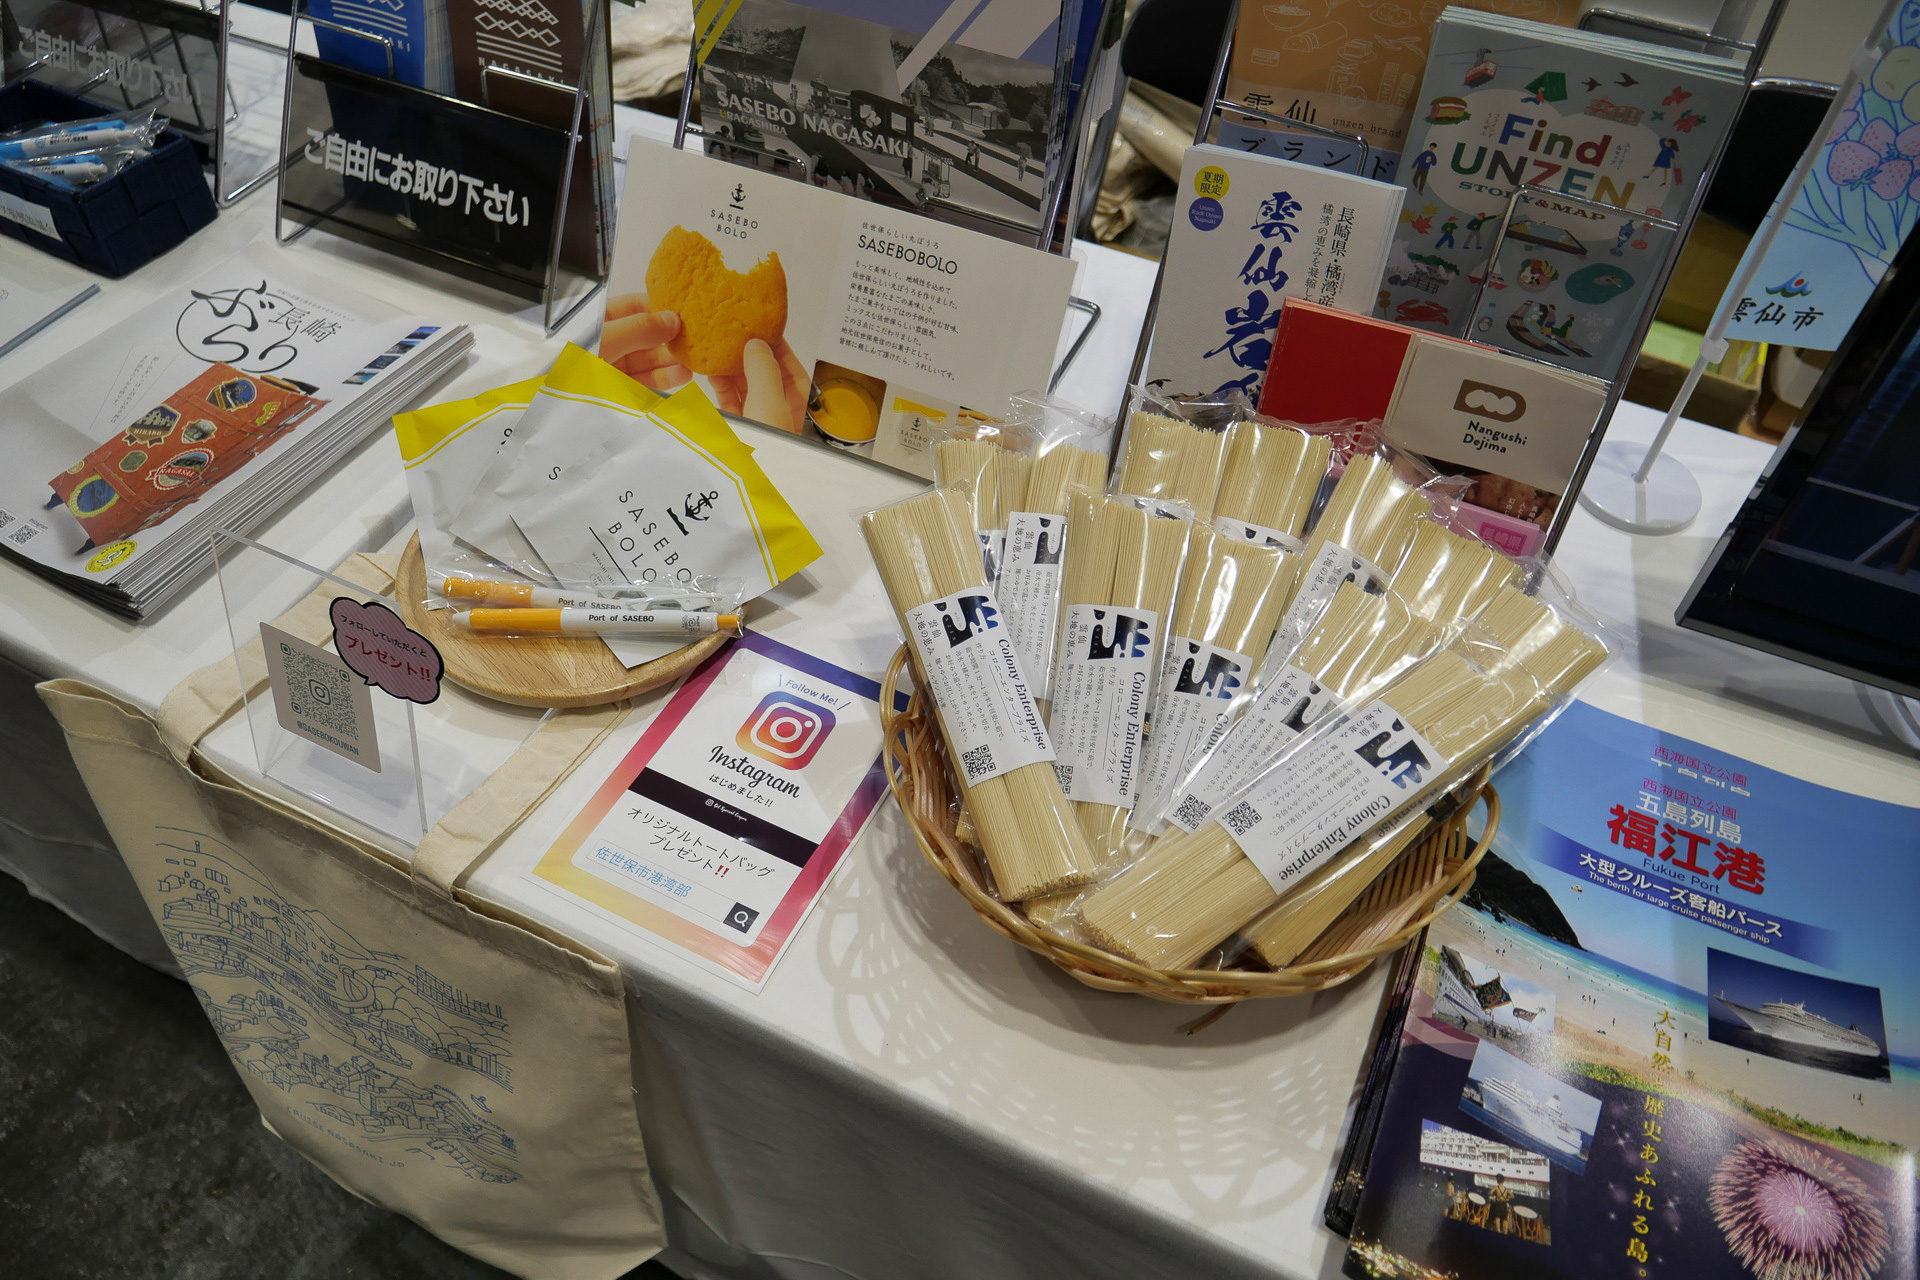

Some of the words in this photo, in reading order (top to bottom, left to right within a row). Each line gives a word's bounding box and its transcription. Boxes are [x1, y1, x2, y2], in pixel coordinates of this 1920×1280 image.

[716, 90, 797, 126] SASEBO
[802, 113, 909, 160] NAGASAKI
[719, 109, 788, 136] URAGASHIRA
[1332, 116, 1365, 131] unzen
[1370, 122, 1402, 138] brand
[1497, 109, 1612, 169] Find
[304, 127, 530, 227] ご自由にお取り下さい
[1203, 171, 1224, 186] 夏期
[1240, 137, 1394, 179] ブランド
[1448, 138, 1636, 215] UNZEN
[1200, 183, 1222, 197] 限定
[710, 209, 759, 230] SASEBO
[716, 224, 748, 240] BOLO
[857, 234, 959, 275] SASEBOBOLO
[268, 306, 343, 344] 長崎
[1462, 433, 1507, 454] Dejima
[1468, 420, 1528, 446] Nangushi
[606, 520, 660, 585] BOLO
[616, 488, 695, 586] SASEBO
[1011, 517, 1025, 563] 大地の恵み
[1023, 530, 1034, 550] 雲仙
[557, 597, 574, 605] Port
[588, 614, 605, 622] Port
[622, 614, 654, 622] SASEBO
[340, 614, 428, 659] フォローしていただくと
[911, 610, 937, 656] 大地の恵み
[926, 618, 942, 639] 雲仙
[974, 641, 986, 660] 作り方
[1065, 609, 1079, 659] 大地の恵み
[1077, 623, 1088, 644] 雲仙
[345, 635, 432, 683] プレゼント!!
[1107, 666, 1117, 685] 作り方
[785, 678, 820, 700] Follow
[819, 690, 839, 706] Me!
[987, 649, 1030, 744] コロニーエンタープライズ
[995, 636, 1023, 682] Colony
[1012, 681, 1049, 751] Enterprise
[1126, 670, 1146, 719] Colony
[1260, 670, 1297, 714] 大地の恵み
[1279, 686, 1299, 708] 雲仙
[1105, 678, 1126, 783] コロニーエンタープライズ
[1337, 705, 1383, 741] 大地の恵み
[1358, 718, 1381, 739] 雲仙
[709, 745, 801, 800] Instagram
[1114, 720, 1139, 796] Enterprise
[1653, 744, 1749, 788] 西海国立公園
[709, 773, 774, 807] はじめました!!
[1642, 777, 1738, 821] 西海国立公園
[1275, 786, 1370, 862] コロニーエンタープライズ
[1342, 791, 1392, 834] Colony
[1635, 790, 1744, 845] 五島列島
[627, 806, 776, 879] オリジナルトートバッグ
[1275, 825, 1348, 885] Enterprise
[1607, 803, 1767, 896] 福江港
[595, 845, 693, 898] 佐世保市港湾部
[1640, 857, 1688, 883] Fukue
[1688, 874, 1722, 895] Port
[1578, 851, 1784, 939] 大型クルーズ客船バース
[1585, 870, 1606, 884] The
[1604, 877, 1632, 894] berth
[1630, 887, 1645, 899] for
[1644, 892, 1671, 910] large
[1670, 902, 1700, 920] cruise
[1699, 913, 1749, 938] passenger
[1748, 930, 1772, 946] ship
[1626, 1009, 1677, 1279] 大自然と歴史あふれる島。
